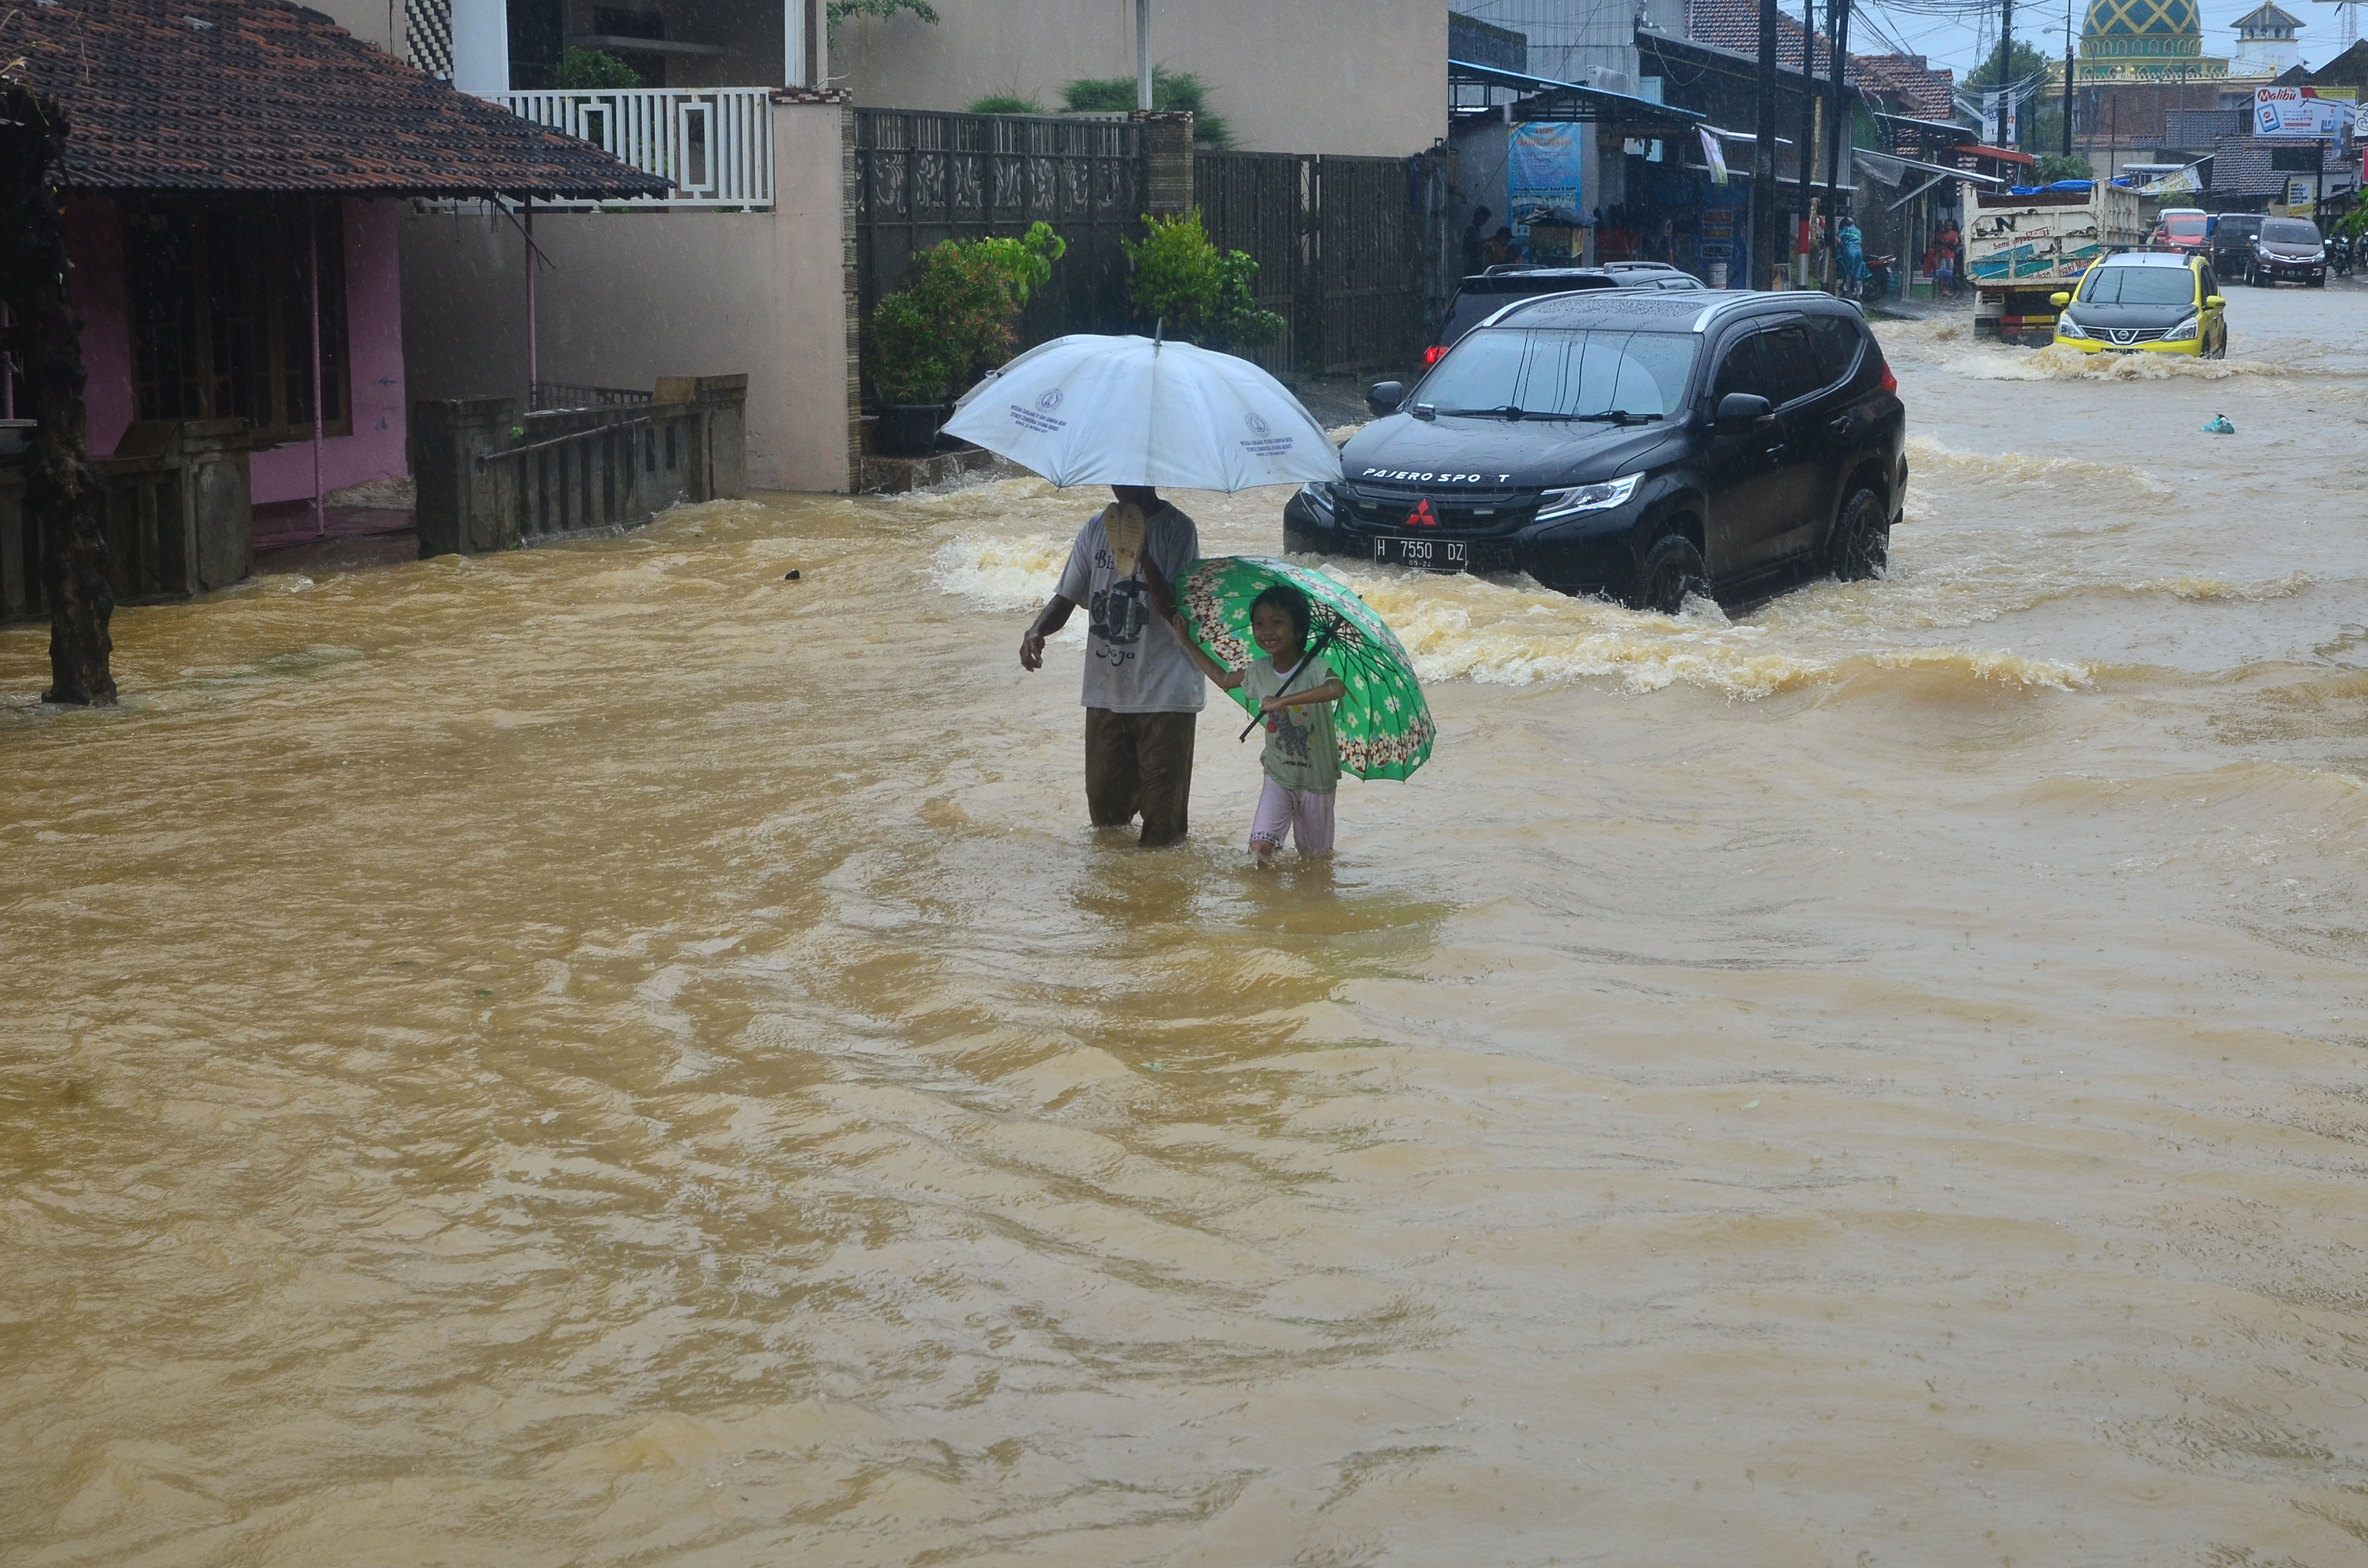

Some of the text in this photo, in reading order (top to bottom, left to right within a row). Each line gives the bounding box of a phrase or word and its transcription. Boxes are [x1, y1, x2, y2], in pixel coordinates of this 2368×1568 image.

[2258, 88, 2296, 102] Malibu
[1362, 468, 1511, 483] PAJERO SPOT
[1377, 539, 1464, 561] H 7550 DZ
